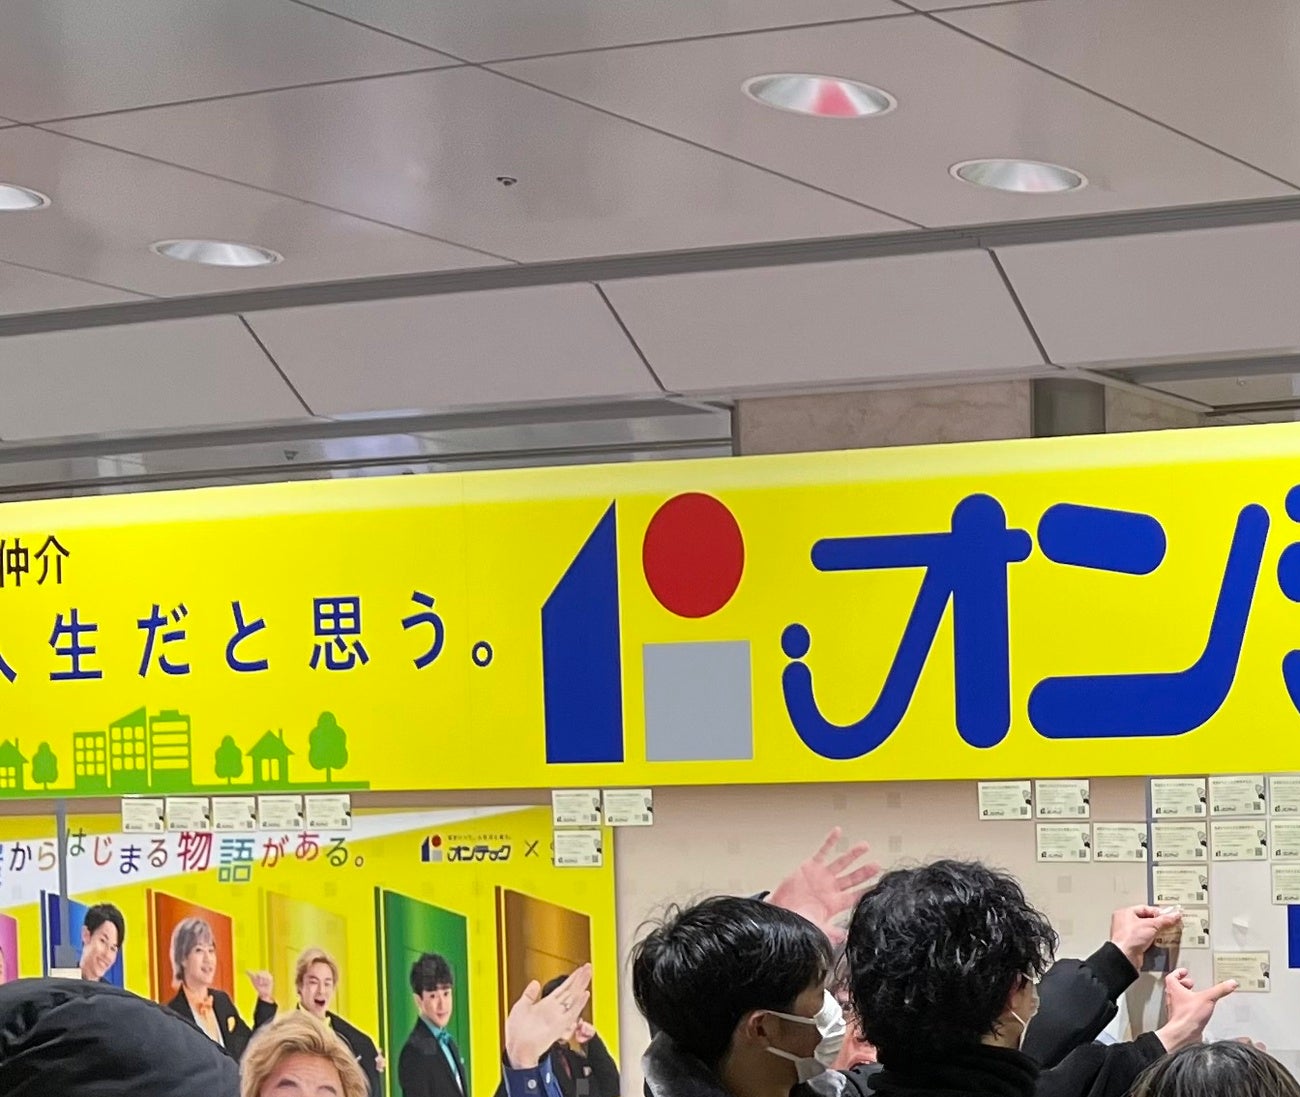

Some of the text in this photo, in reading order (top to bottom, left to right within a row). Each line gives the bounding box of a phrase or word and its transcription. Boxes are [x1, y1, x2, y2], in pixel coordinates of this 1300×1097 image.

[0, 535, 70, 588] 仲介
[0, 826, 364, 888] からはじまる物語がある。
